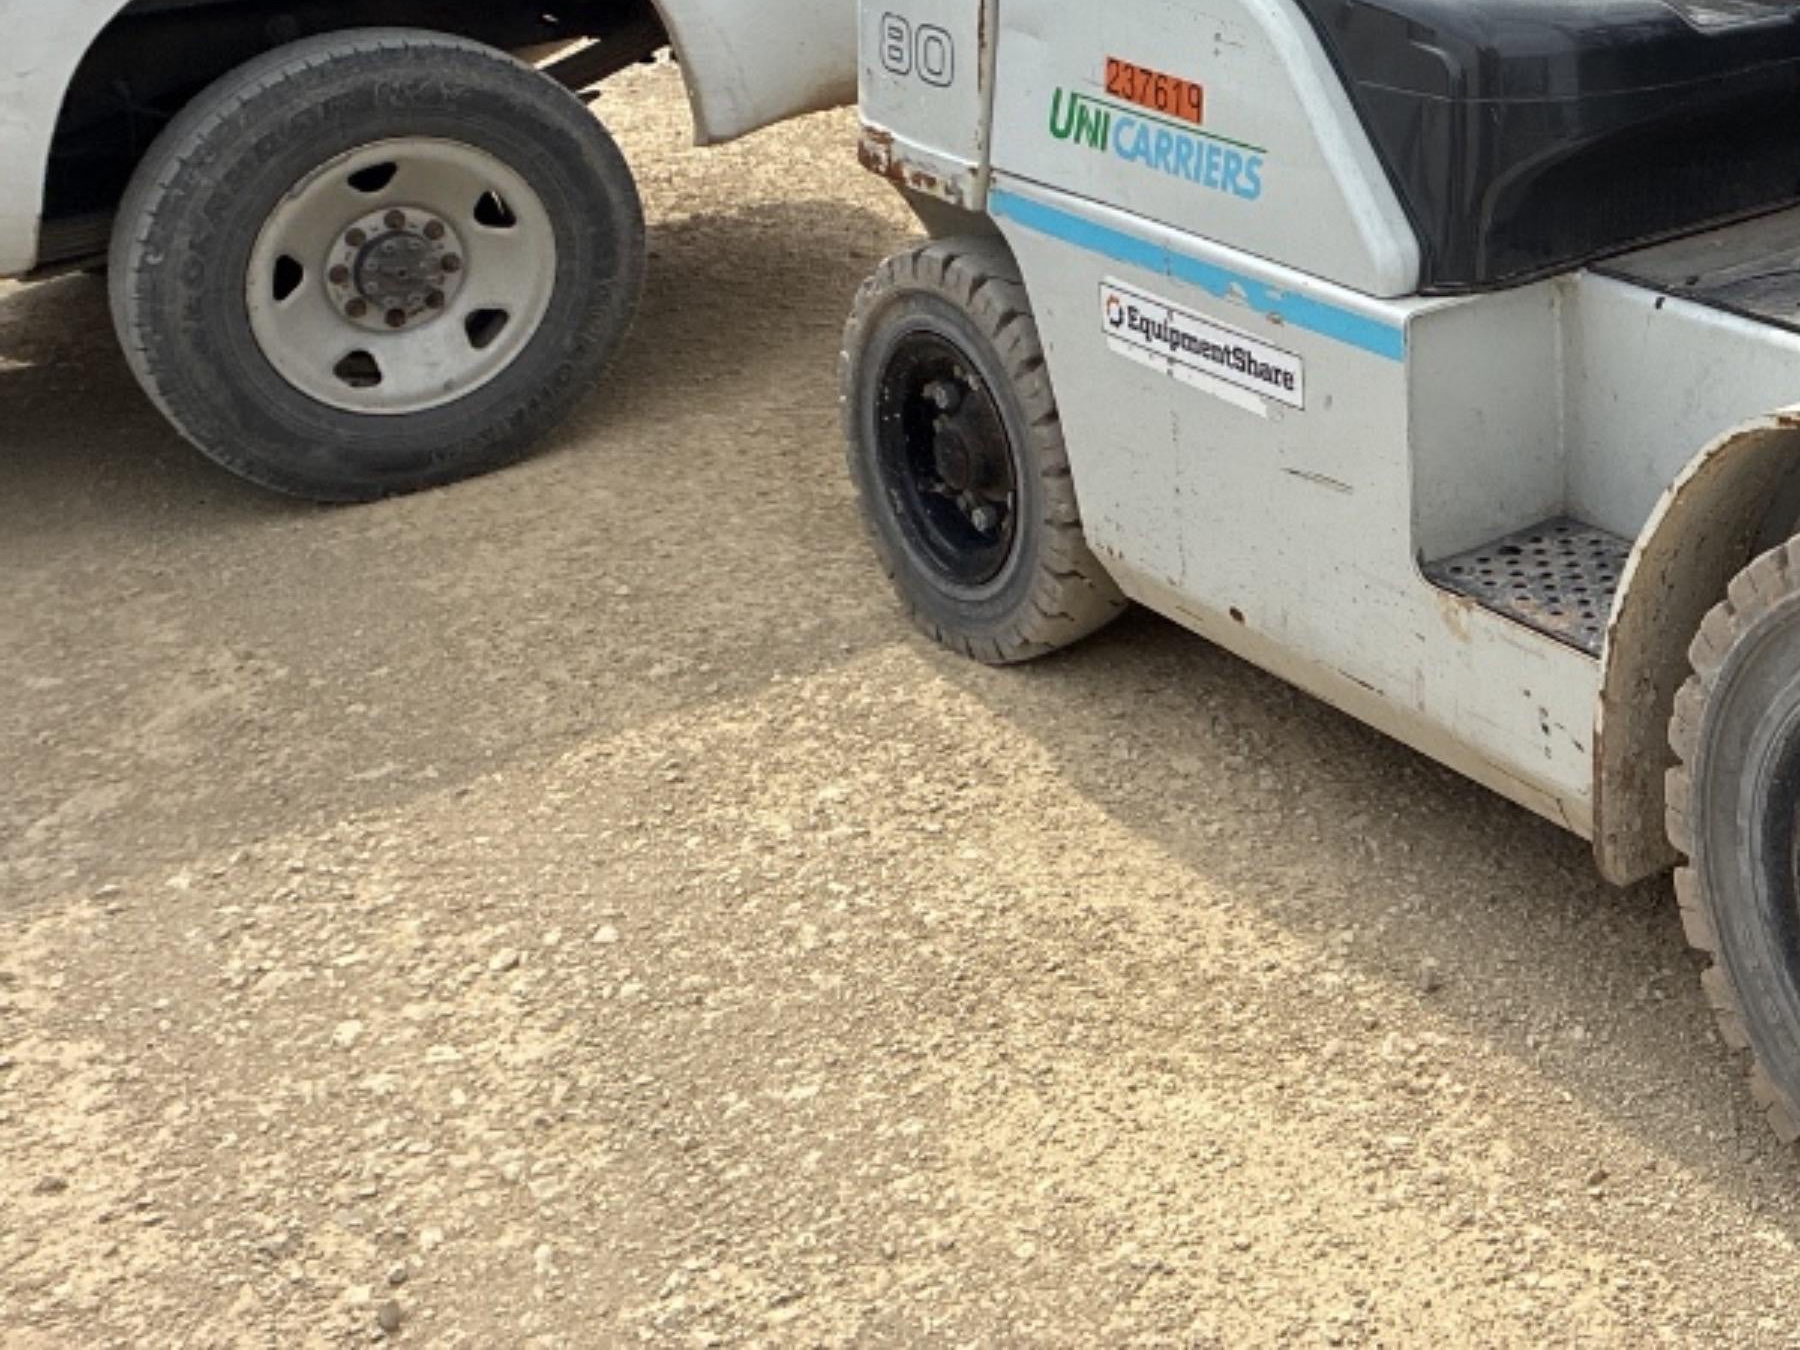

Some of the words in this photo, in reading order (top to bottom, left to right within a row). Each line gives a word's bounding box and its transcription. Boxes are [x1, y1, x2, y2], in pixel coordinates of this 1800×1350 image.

[880, 11, 954, 88] 80
[1106, 57, 1203, 124] 237619
[1049, 86, 1267, 200] UNICARRIERS
[1127, 305, 1295, 391] EquipmentShare
